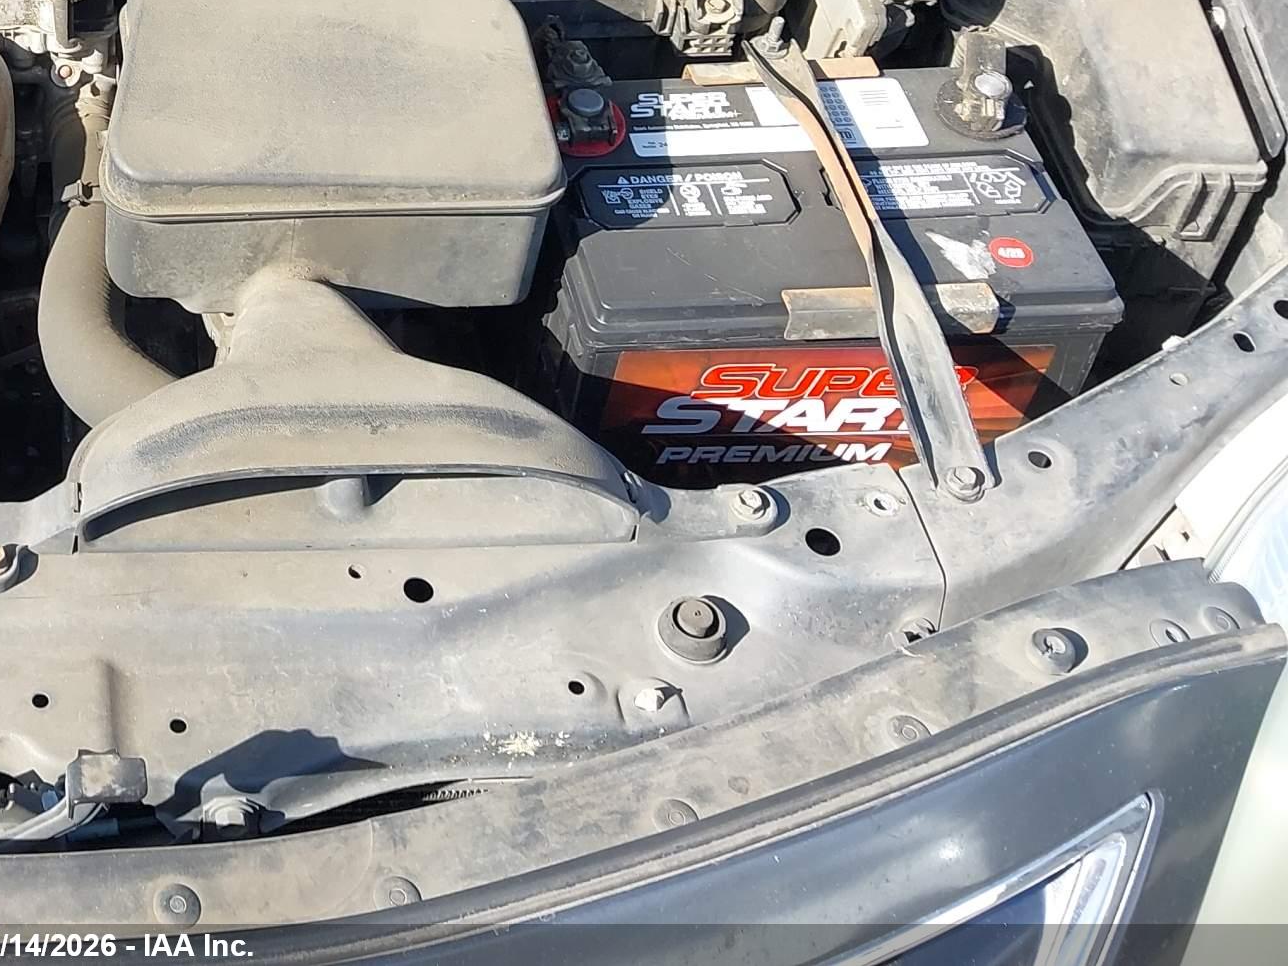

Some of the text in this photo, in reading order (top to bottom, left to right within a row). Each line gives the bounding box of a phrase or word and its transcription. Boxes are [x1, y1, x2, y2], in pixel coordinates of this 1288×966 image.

[629, 174, 684, 184] DANGER
[694, 171, 743, 182] POISON
[640, 395, 910, 435] STAR
[656, 442, 893, 465] PREMIUM
